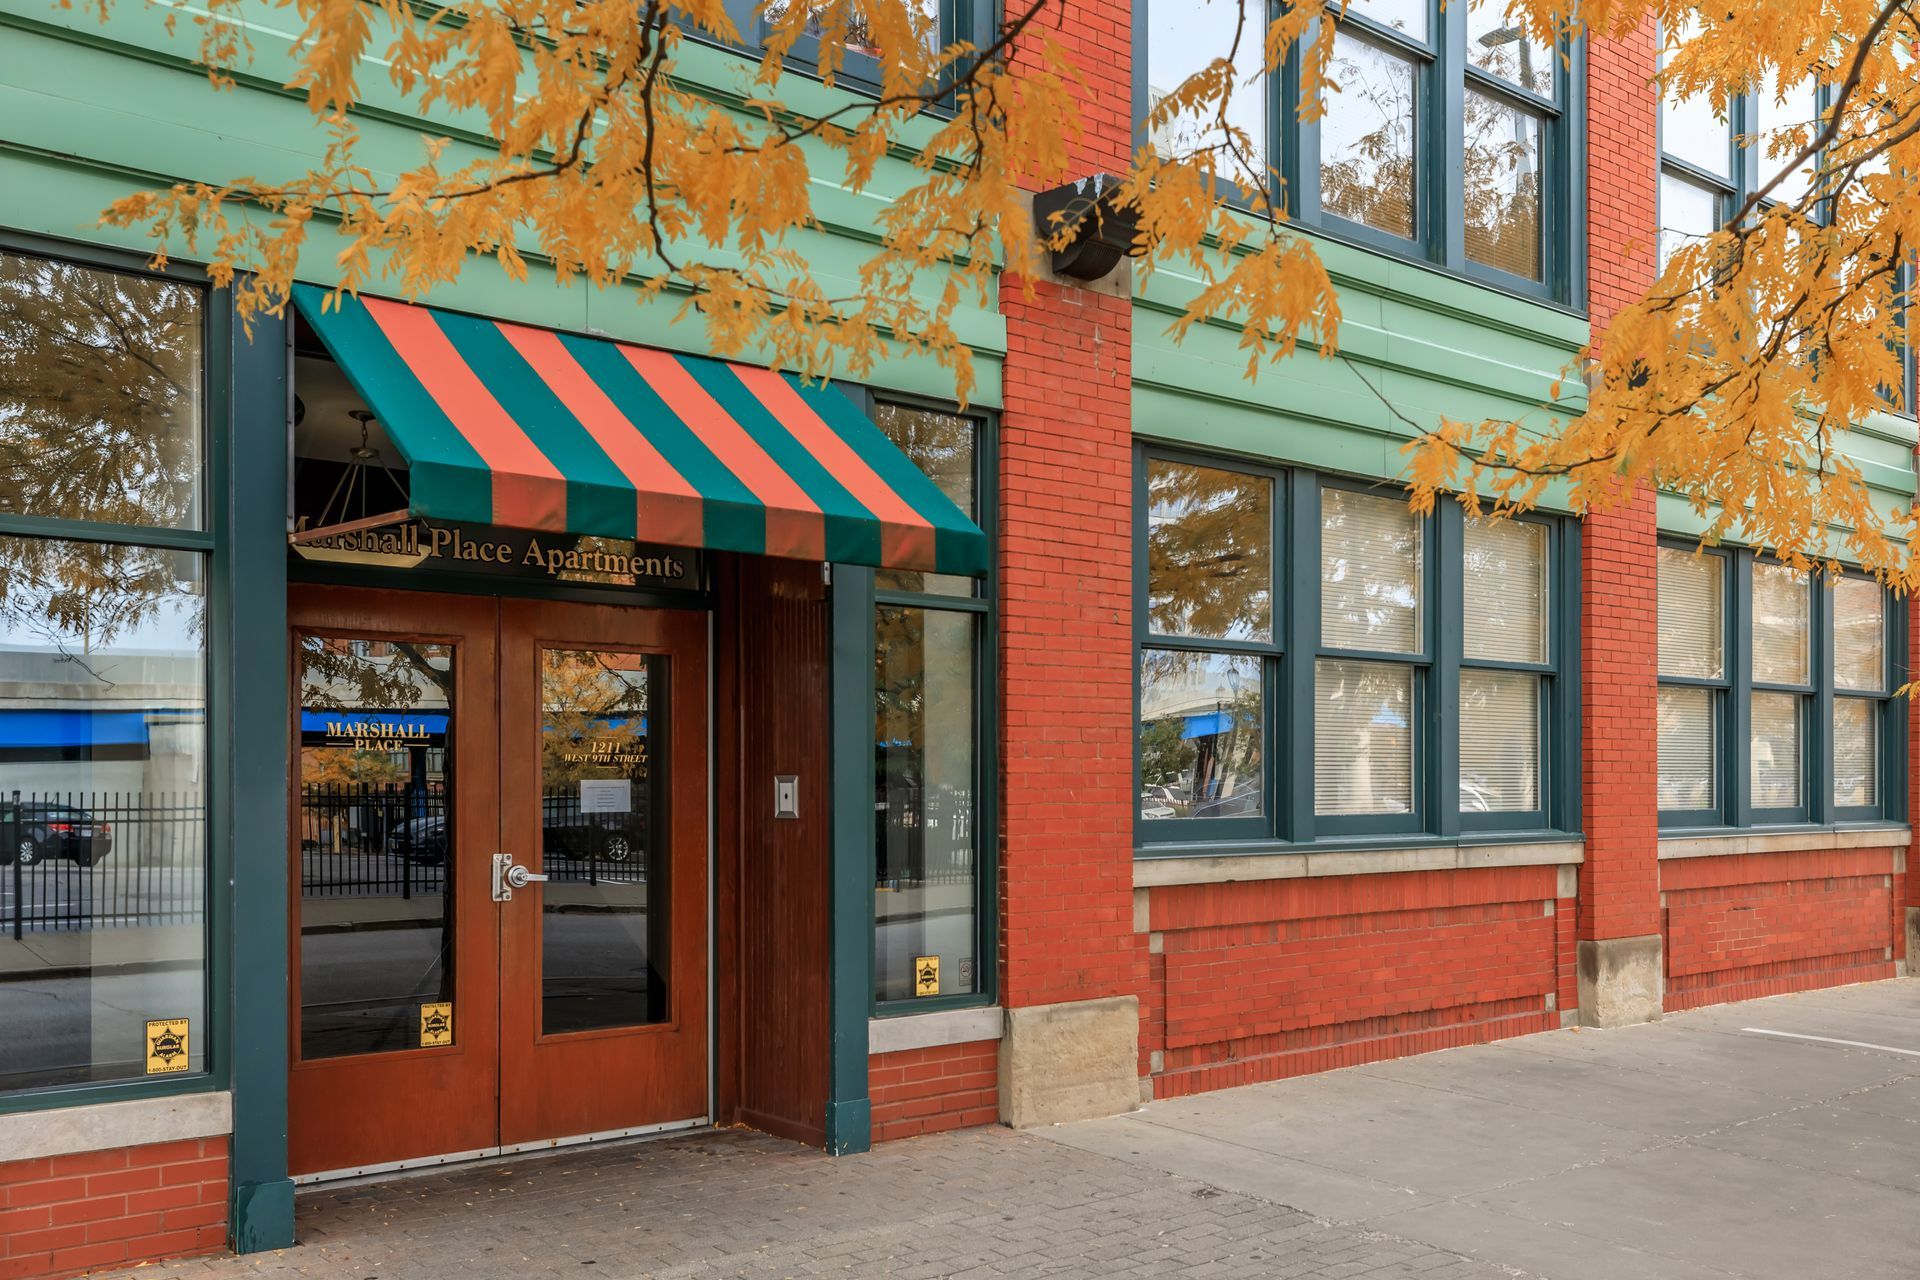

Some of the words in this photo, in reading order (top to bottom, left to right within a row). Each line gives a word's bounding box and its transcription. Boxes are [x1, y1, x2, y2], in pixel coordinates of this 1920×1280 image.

[429, 527, 513, 564] Place
[521, 537, 684, 578] Apartments
[326, 722, 430, 739] MARSHALL
[354, 739, 403, 751] PLACE
[591, 741, 620, 753] 1211
[564, 753, 590, 762] WEST
[592, 754, 611, 763] 9TH
[613, 754, 648, 763] STREET
[156, 1034, 180, 1045] GUARDIAN
